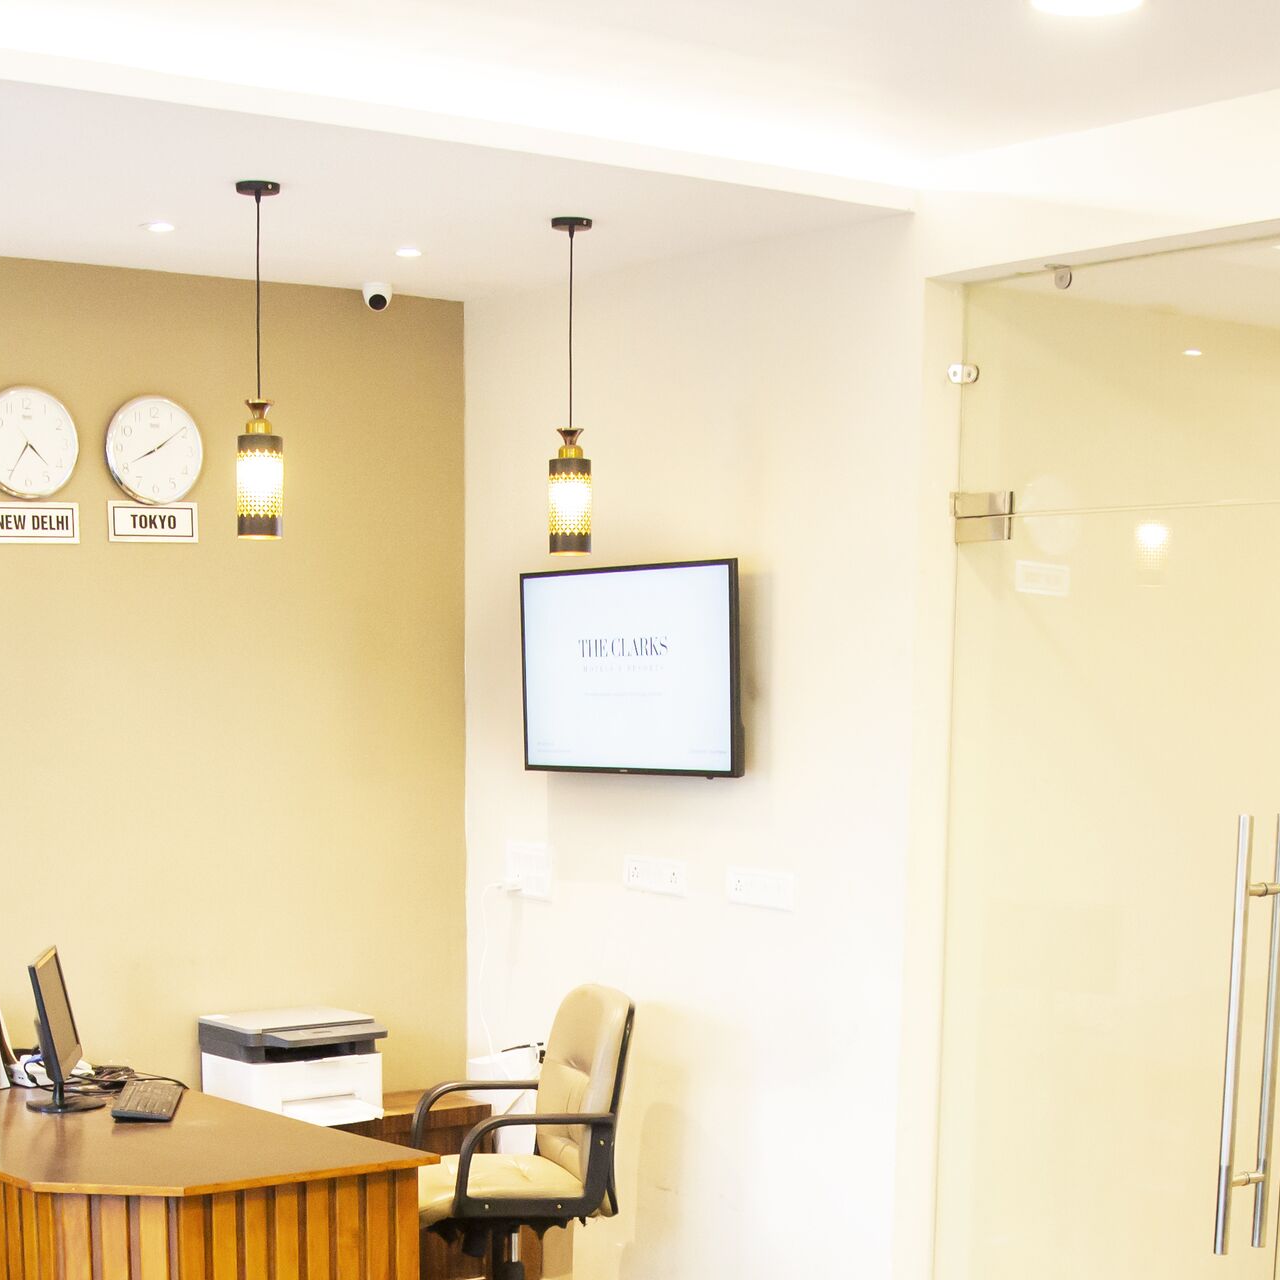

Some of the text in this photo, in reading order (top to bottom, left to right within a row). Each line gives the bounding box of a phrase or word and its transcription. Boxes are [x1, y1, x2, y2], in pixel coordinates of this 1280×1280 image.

[32, 514, 69, 531] DELHI
[130, 514, 177, 530] TOKYO
[578, 635, 669, 658] THE CLARKS
